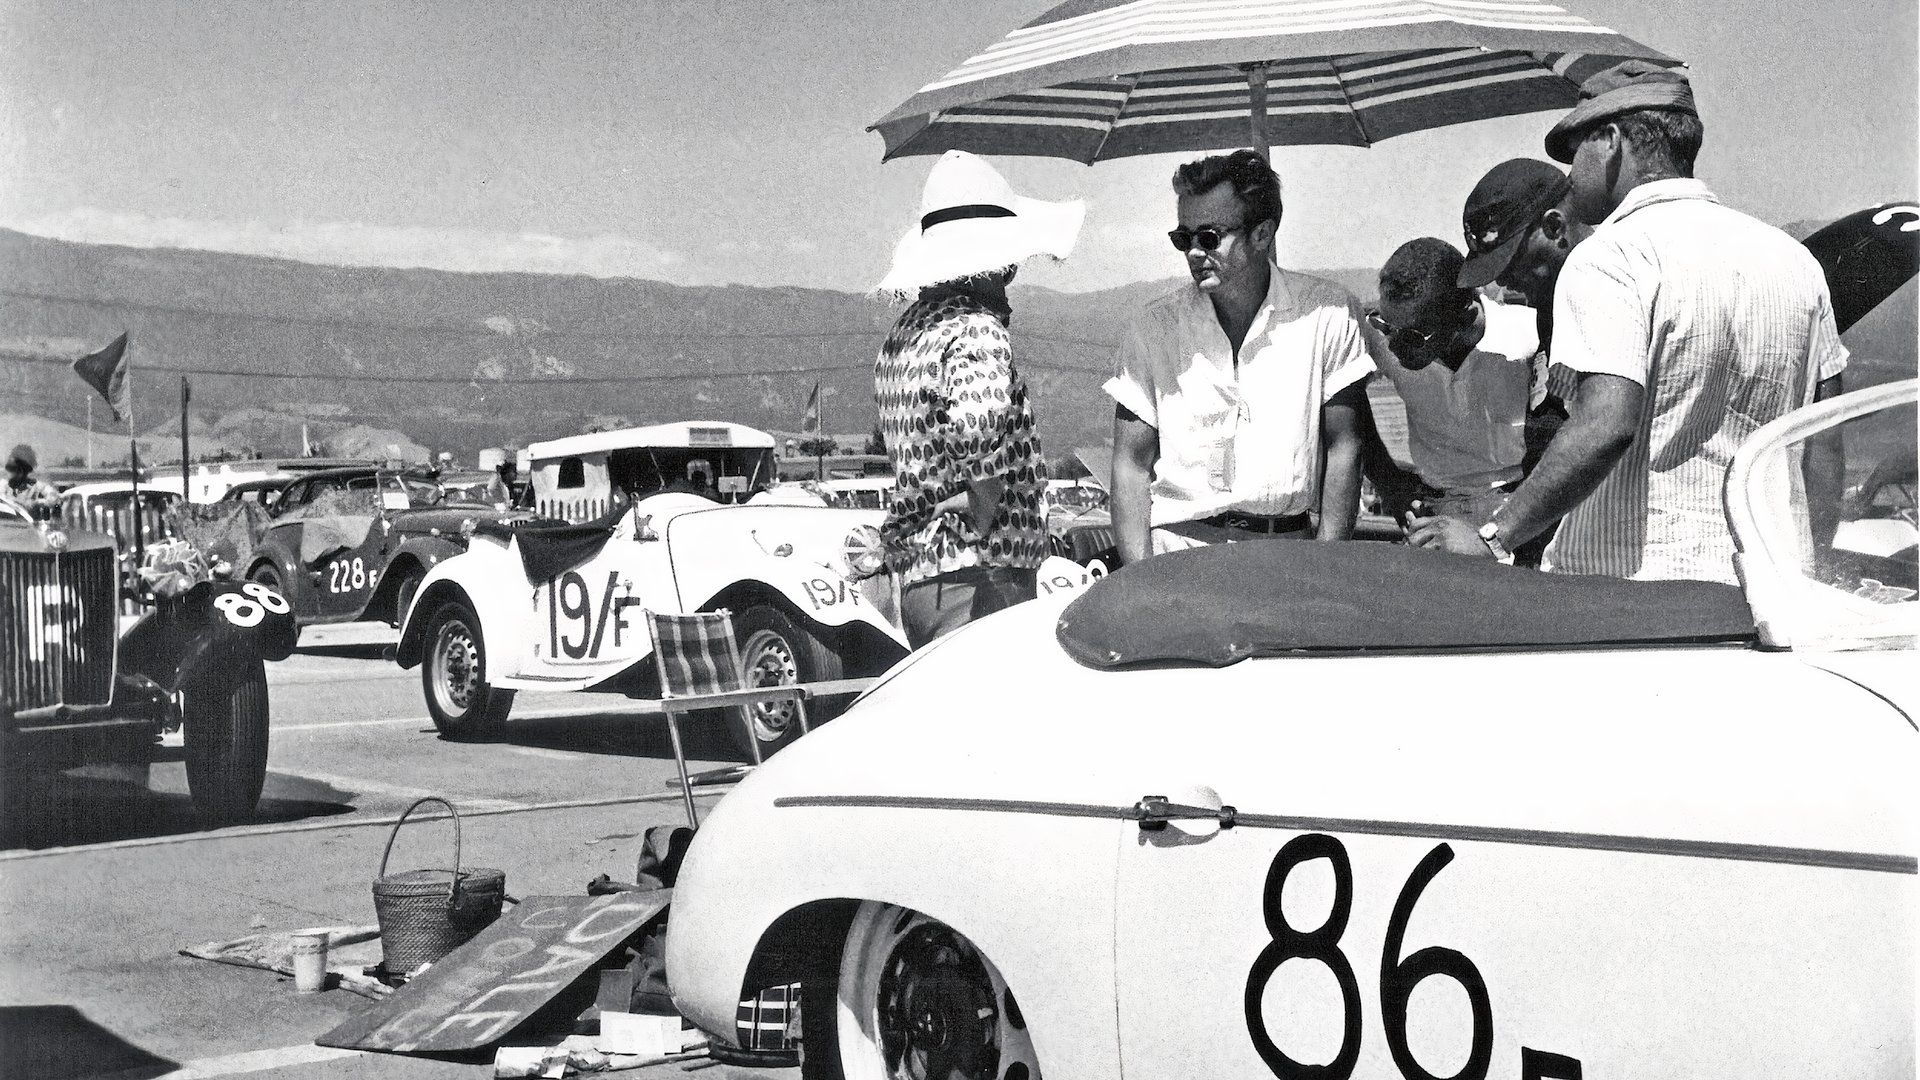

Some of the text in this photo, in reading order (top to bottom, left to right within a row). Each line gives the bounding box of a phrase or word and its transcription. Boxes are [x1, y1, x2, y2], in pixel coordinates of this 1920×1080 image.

[213, 583, 291, 628] 88
[424, 902, 657, 1042] DALE
[1244, 833, 1493, 1080] 86
